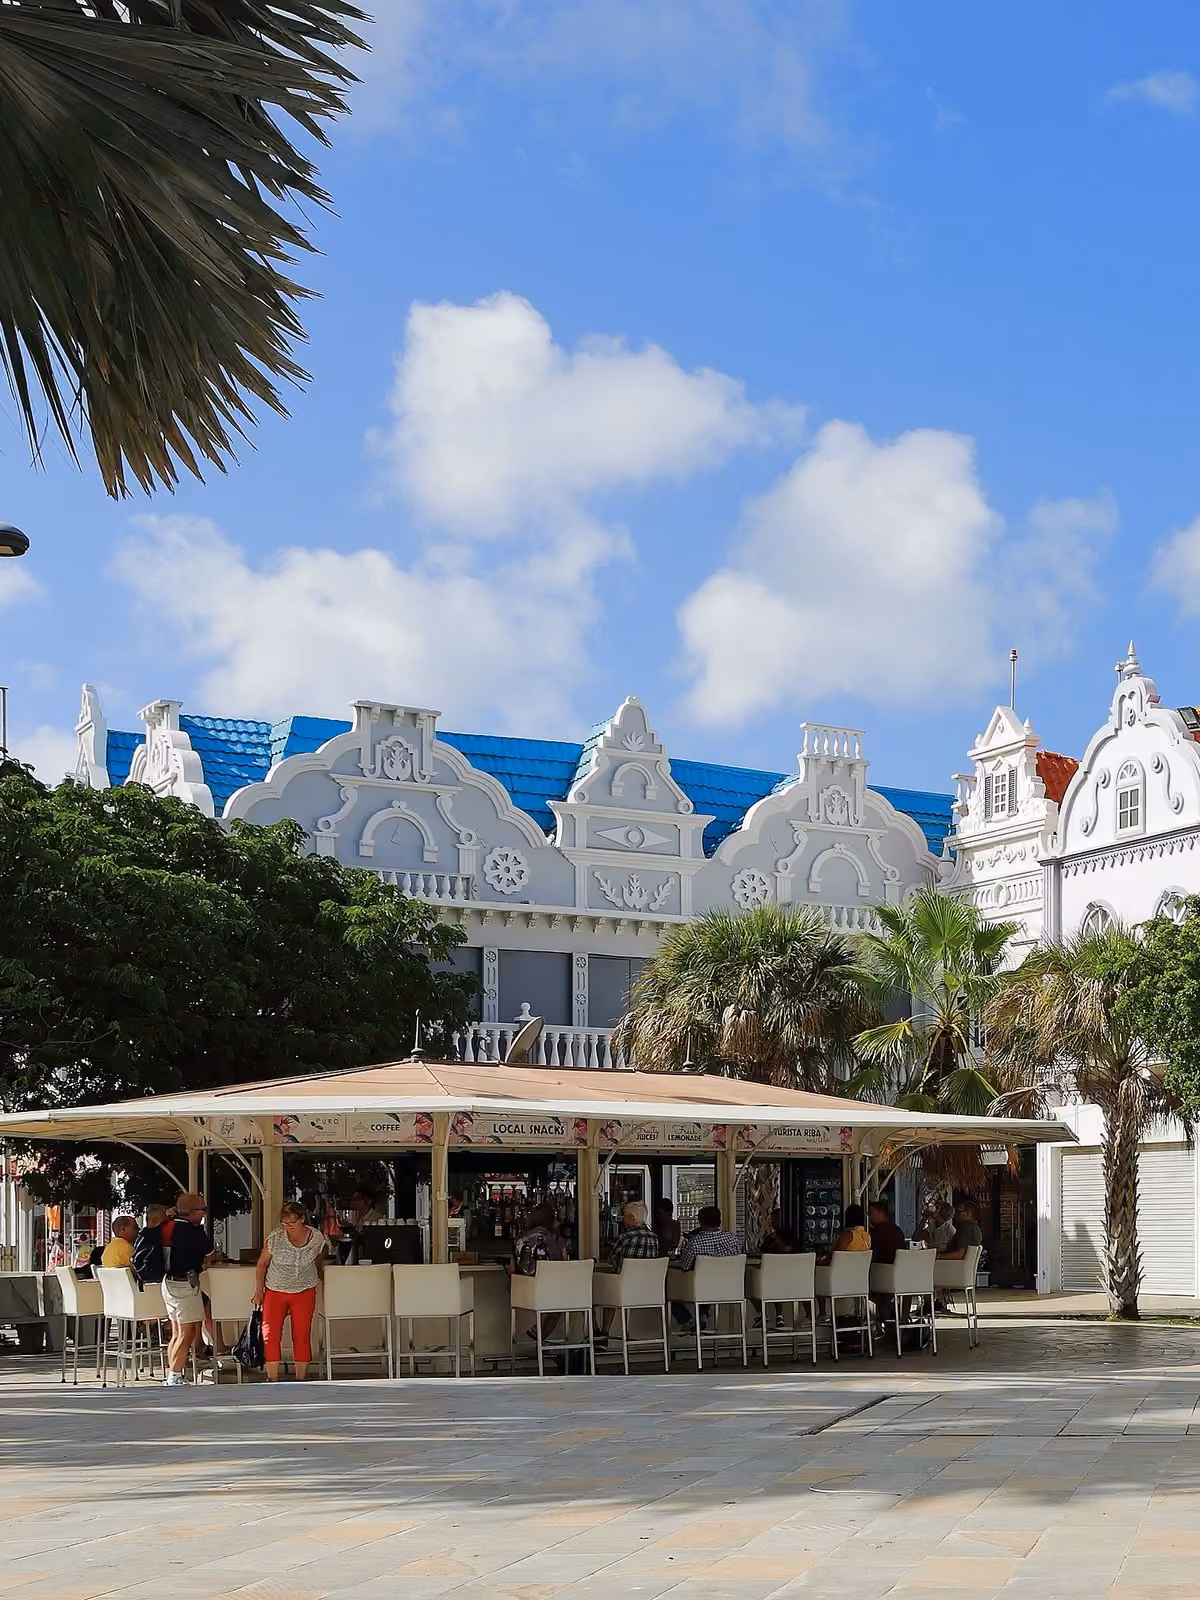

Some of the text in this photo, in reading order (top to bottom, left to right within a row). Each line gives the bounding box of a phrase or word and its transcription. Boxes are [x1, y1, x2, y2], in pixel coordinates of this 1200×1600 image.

[370, 1123, 400, 1131] COFFEE
[493, 1124, 565, 1135] LOCAL SNACKS
[804, 1128, 822, 1137] RIBA
